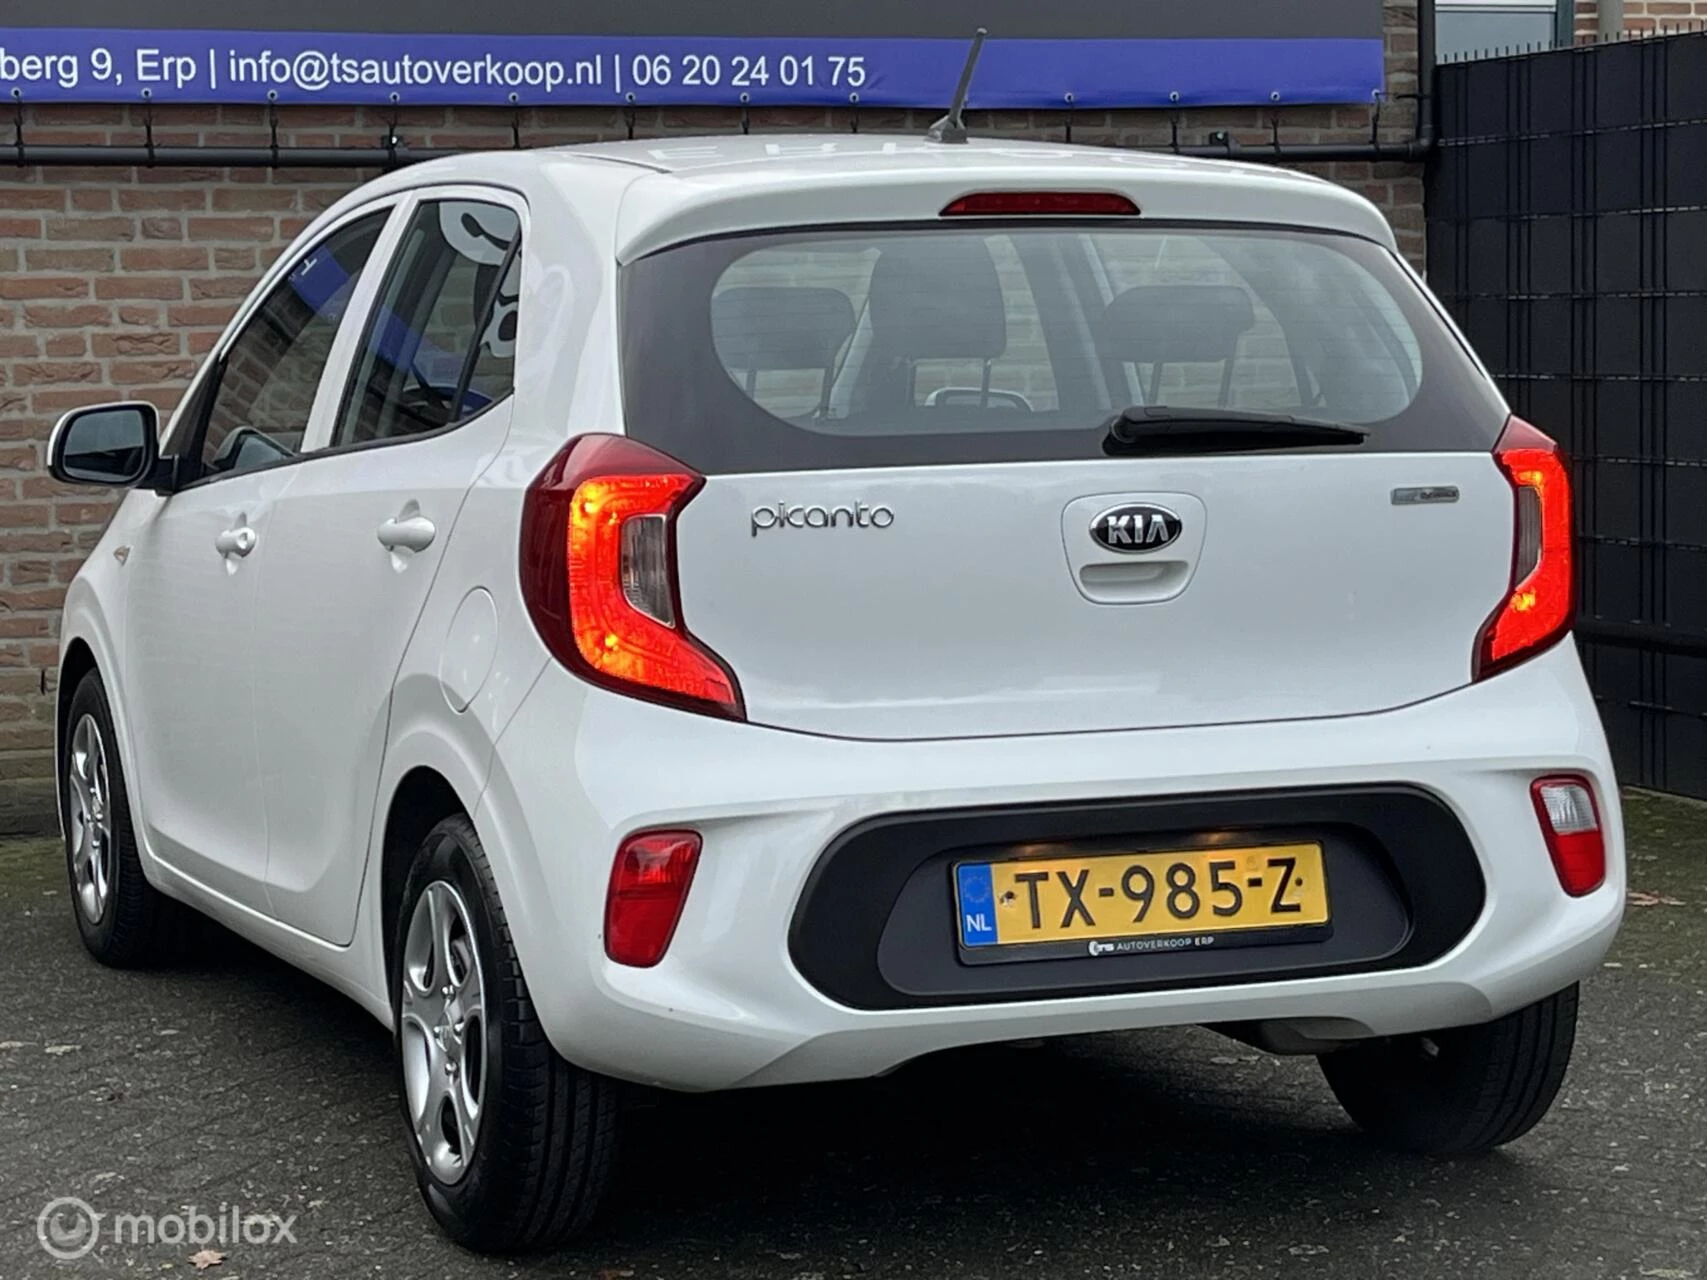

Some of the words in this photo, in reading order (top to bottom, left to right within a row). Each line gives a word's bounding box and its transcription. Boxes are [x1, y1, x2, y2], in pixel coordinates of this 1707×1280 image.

[91, 48, 122, 86] 9,
[136, 48, 196, 89] Erp
[229, 50, 602, 92] info@tsautoverkoop.nl
[632, 54, 672, 86] 06
[682, 54, 721, 86] 20
[731, 56, 769, 86] 24
[779, 55, 814, 86] 01
[828, 57, 866, 87] 75
[751, 499, 894, 538] picanto
[1106, 513, 1169, 544] KIA
[1014, 857, 1302, 931] TX-985-Z
[965, 913, 993, 933] NL
[1116, 937, 1192, 951] AUTOVERKOOP
[1194, 935, 1214, 946] ERP
